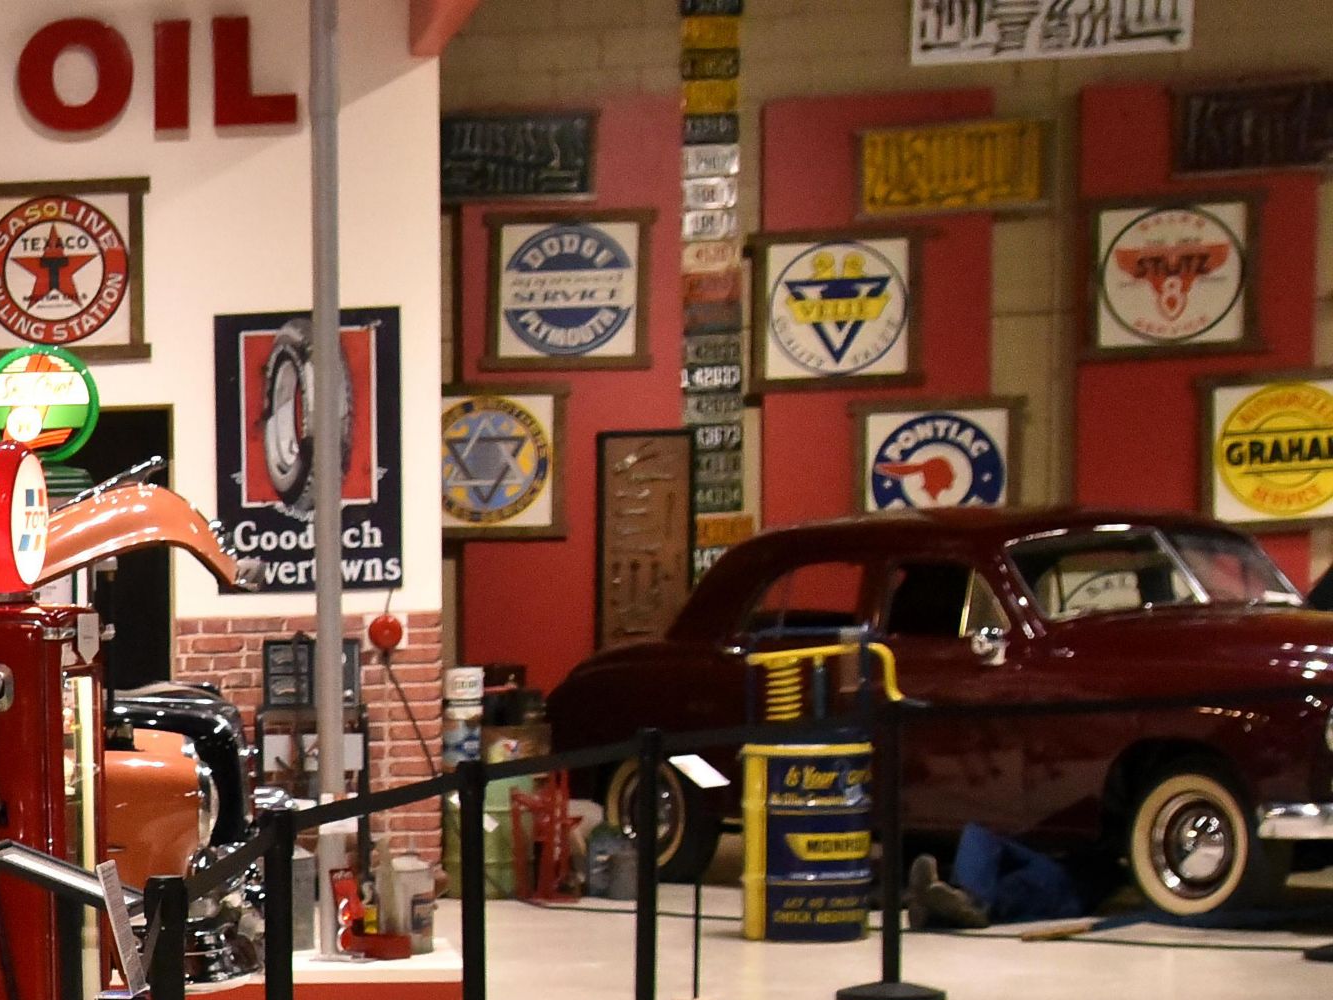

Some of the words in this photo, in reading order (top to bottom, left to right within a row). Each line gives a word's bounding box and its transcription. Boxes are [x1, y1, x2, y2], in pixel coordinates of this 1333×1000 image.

[17, 15, 299, 133] OIL
[22, 236, 89, 251] TEXACO
[40, 257, 69, 291] T
[1136, 253, 1210, 279] STUTZ
[53, 272, 124, 341] STATION
[884, 419, 990, 461] PONTIAC
[234, 519, 383, 552] Goodch
[236, 555, 401, 585] vertwns
